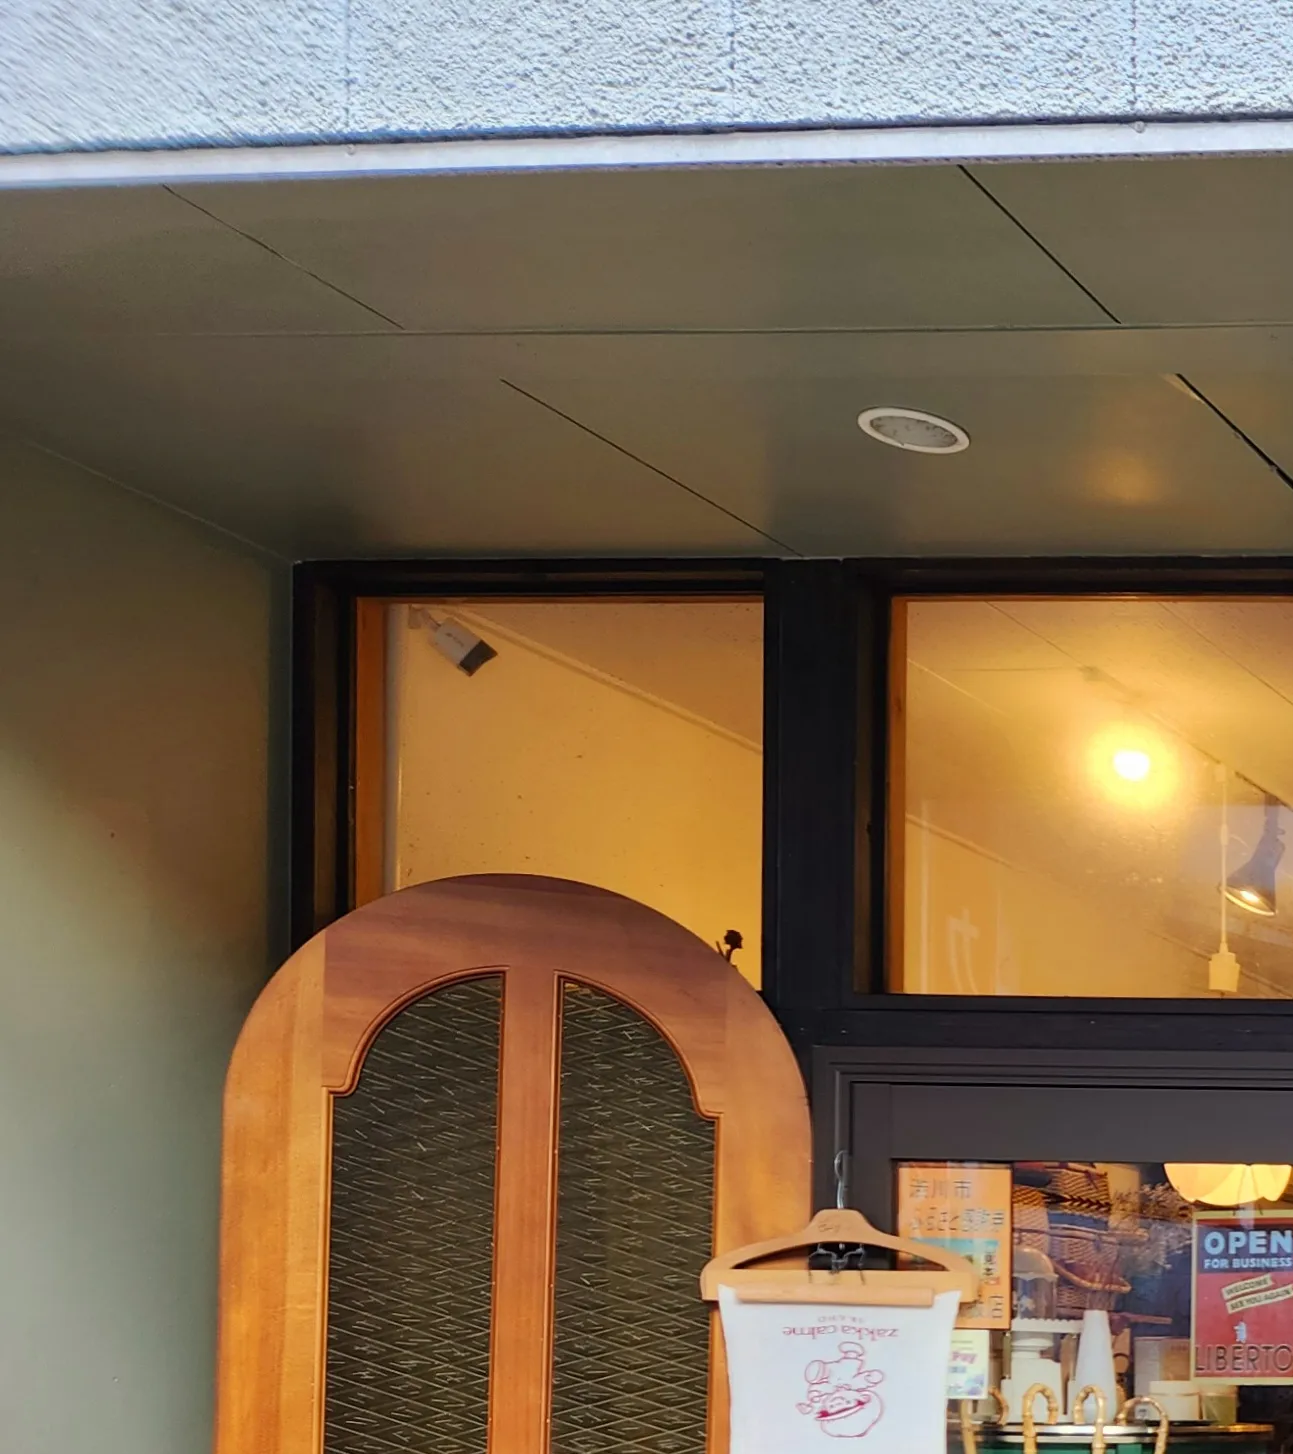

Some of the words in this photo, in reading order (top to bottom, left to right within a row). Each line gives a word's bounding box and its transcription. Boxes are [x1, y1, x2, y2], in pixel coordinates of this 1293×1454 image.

[1204, 1230, 1293, 1255] OPEN
[1204, 1259, 1229, 1269] FOR
[1232, 1257, 1293, 1269] BUSINESS
[1225, 1278, 1270, 1297] WELCOME
[1263, 1289, 1292, 1302] AGAIN
[782, 1325, 837, 1340] calme
[842, 1325, 899, 1341] zakka
[1194, 1344, 1293, 1373] LIBERTO
